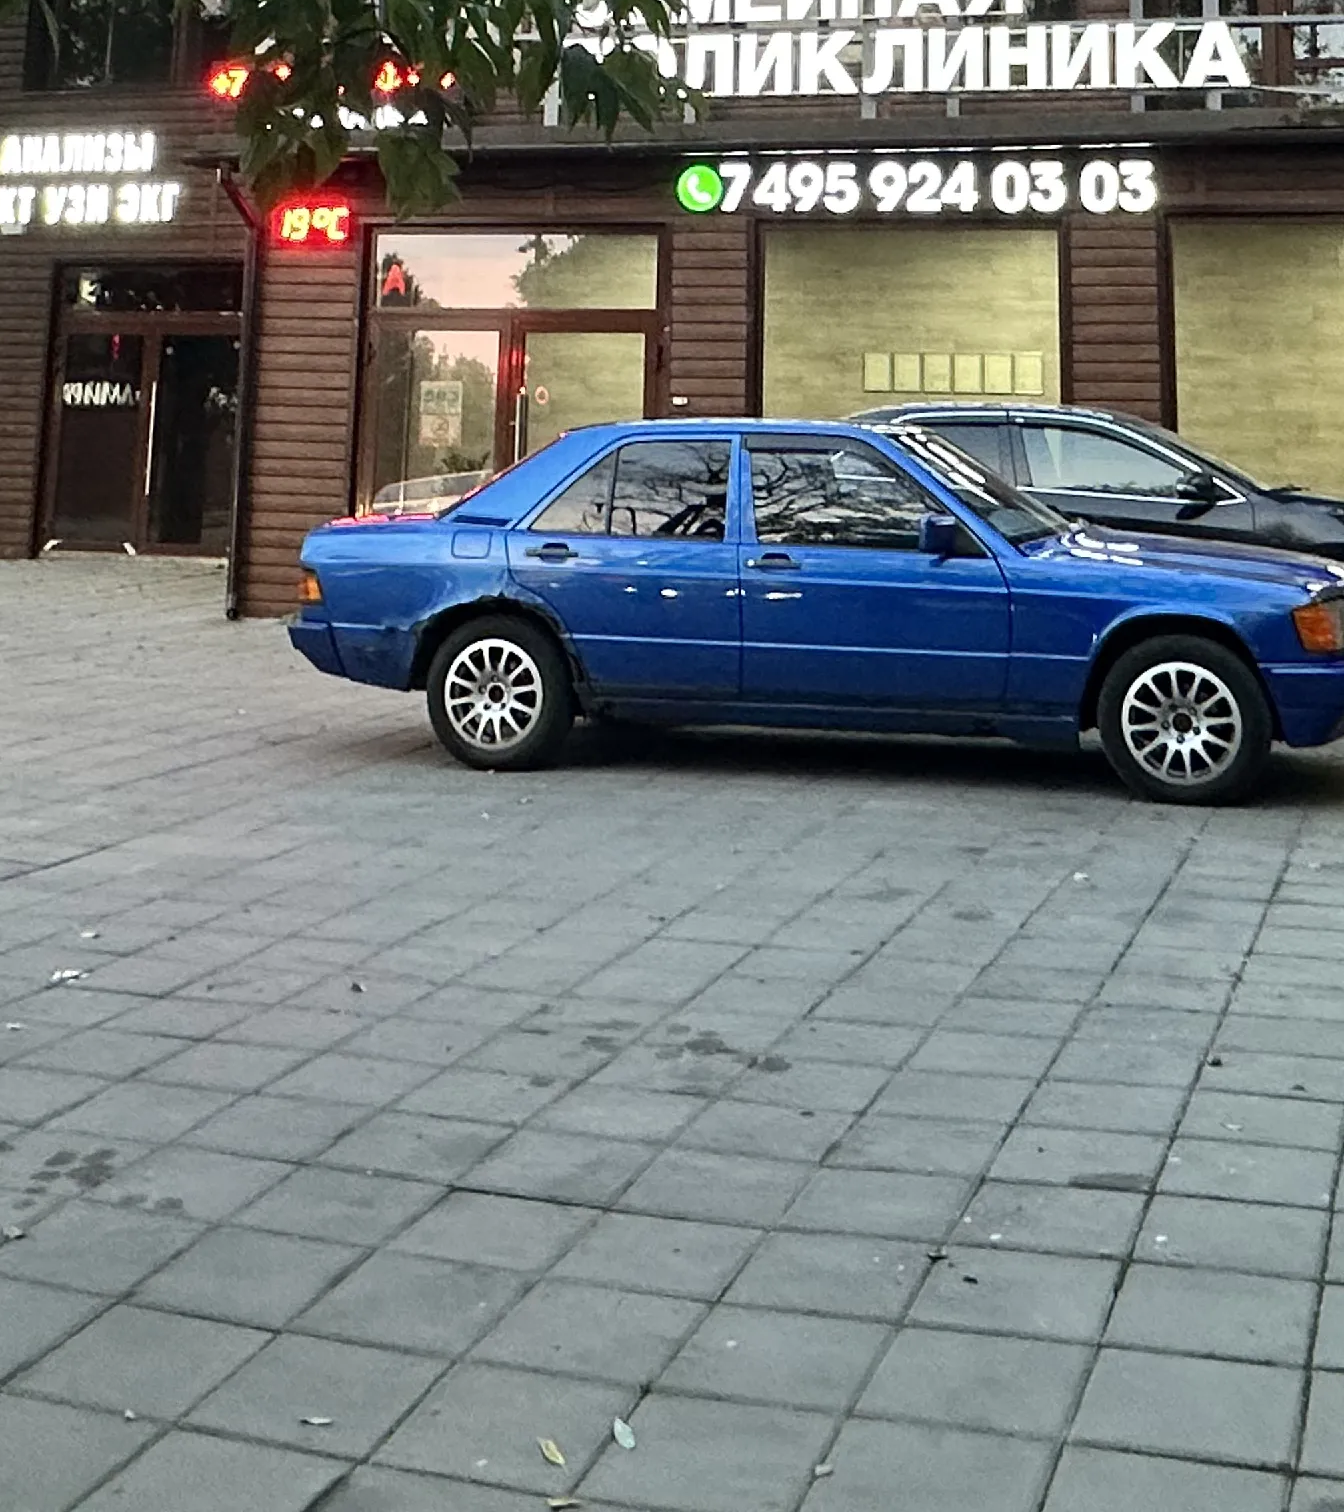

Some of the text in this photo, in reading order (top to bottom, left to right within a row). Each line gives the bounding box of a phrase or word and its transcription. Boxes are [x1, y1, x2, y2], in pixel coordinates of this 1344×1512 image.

[44, 184, 109, 225] УЗИ
[115, 182, 180, 224] ЭКГ
[718, 160, 1157, 214] 7 495 924 03 03
